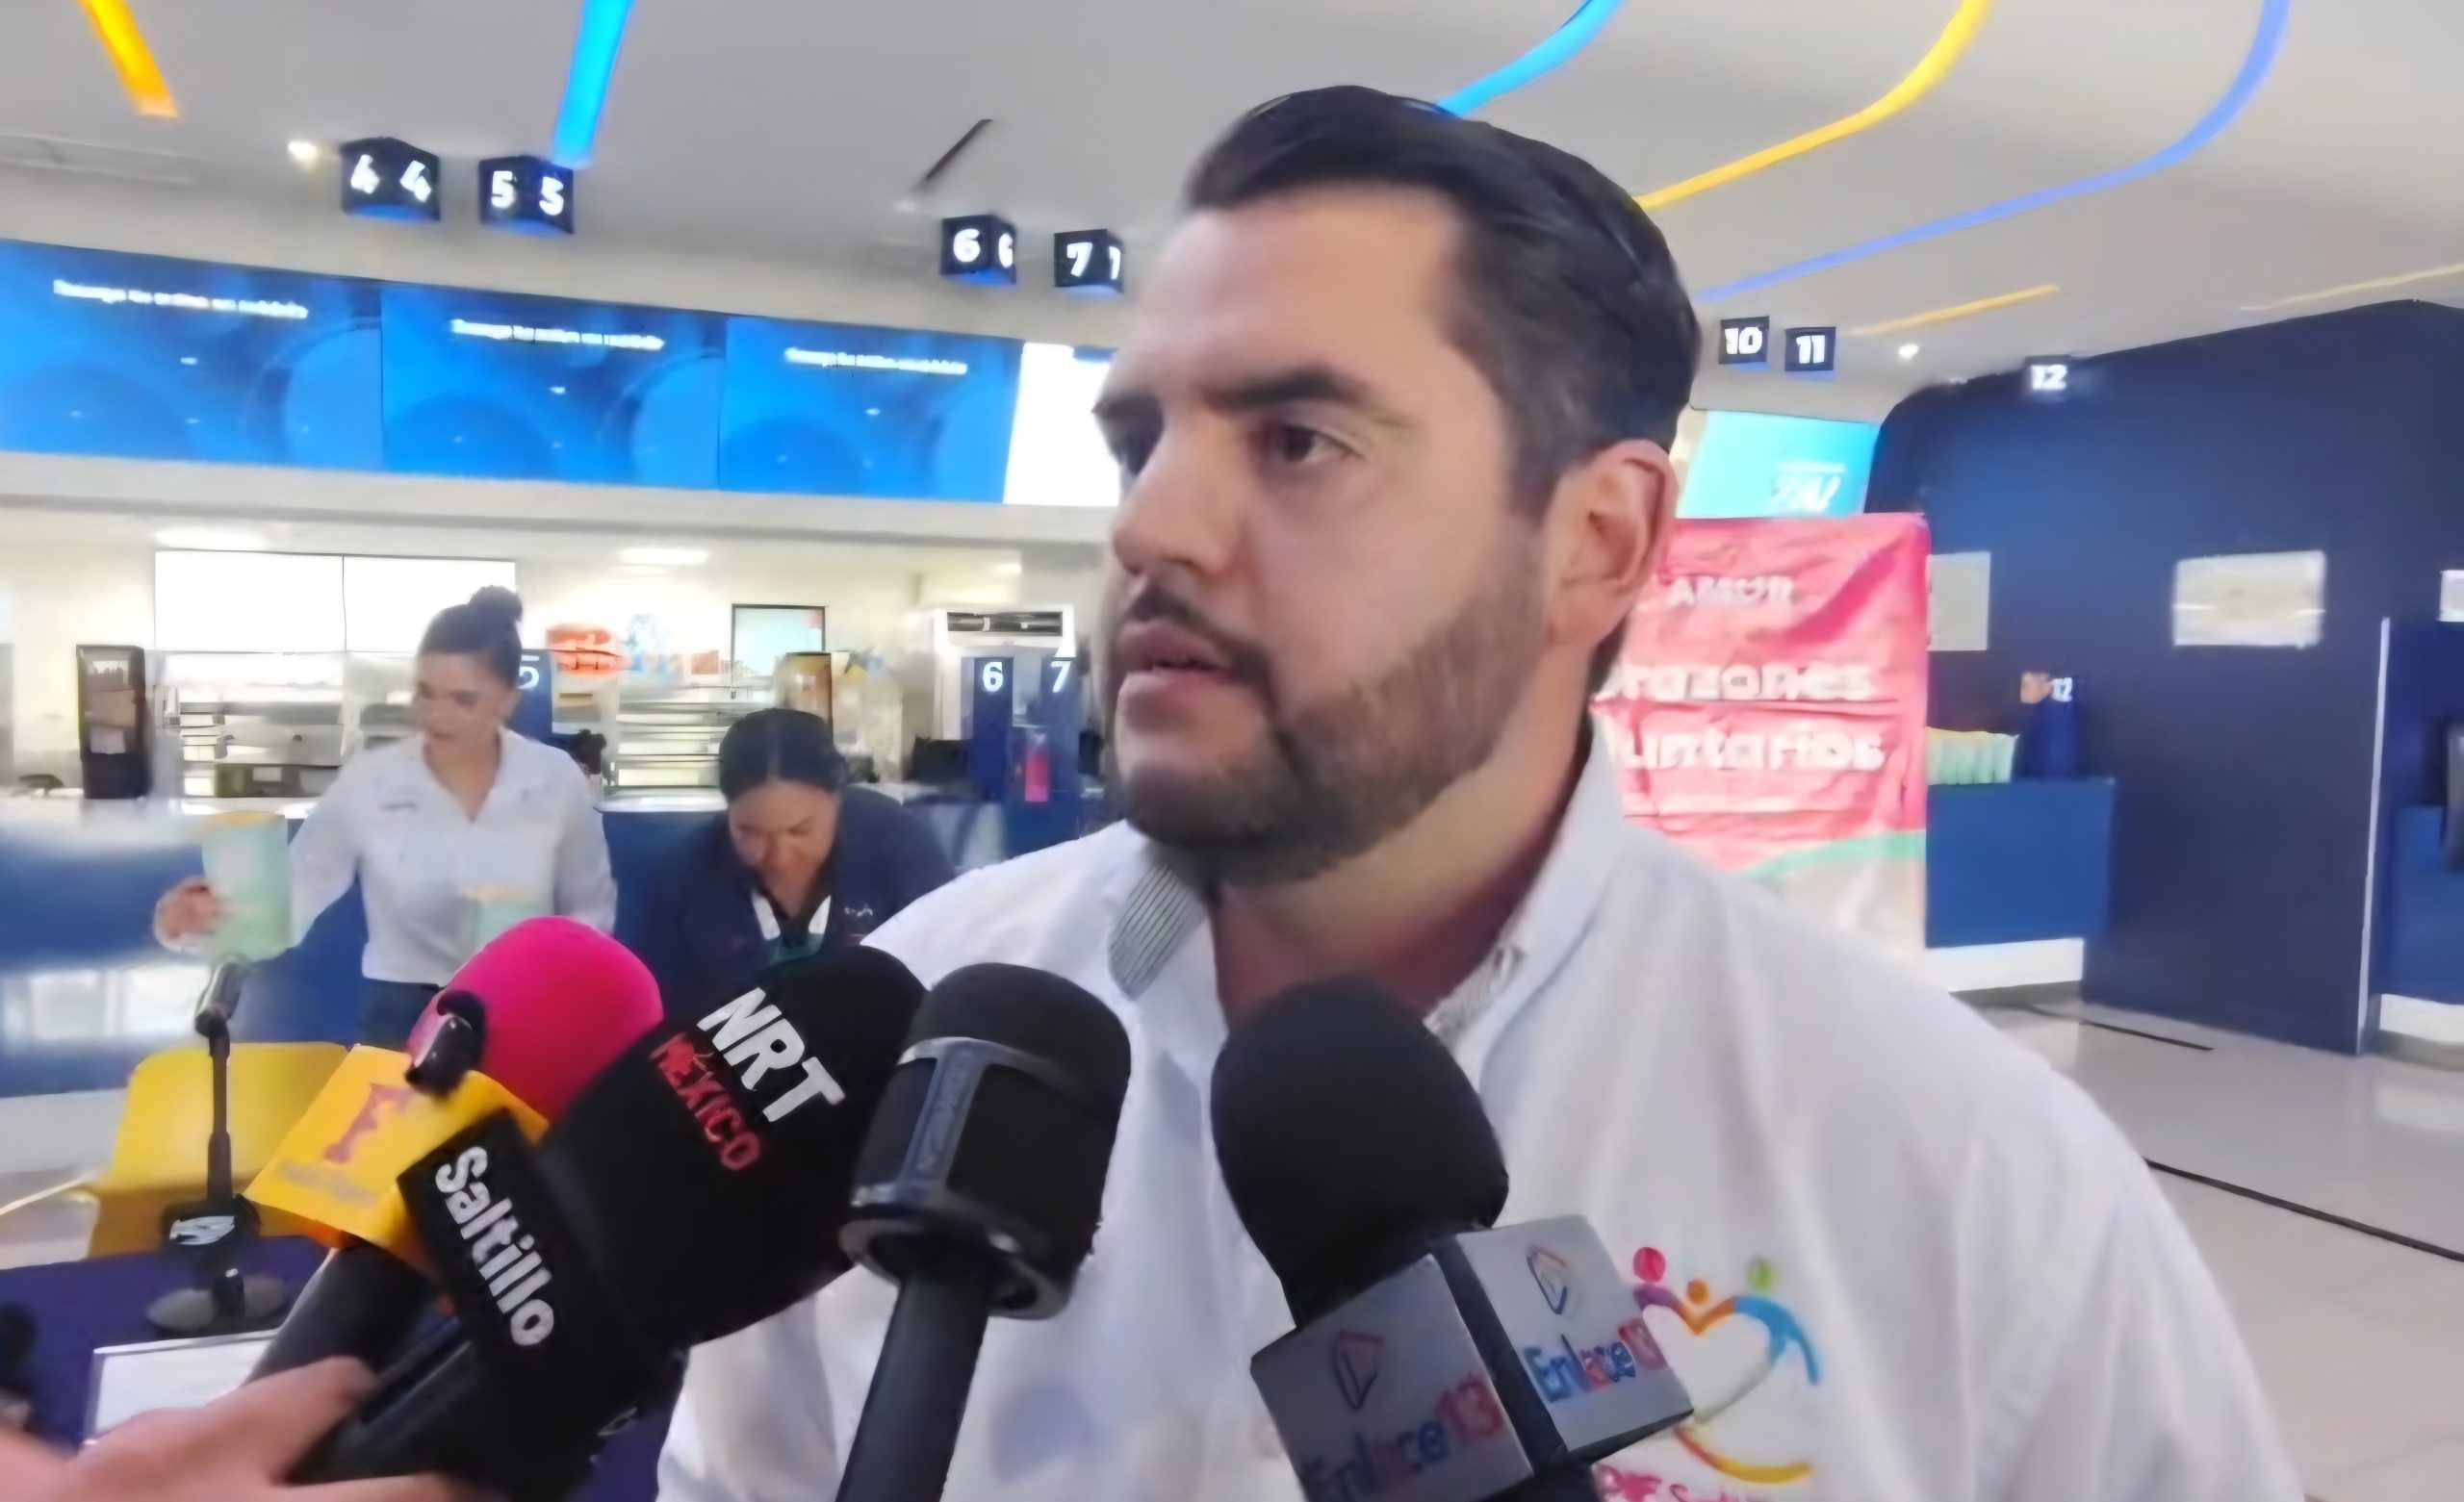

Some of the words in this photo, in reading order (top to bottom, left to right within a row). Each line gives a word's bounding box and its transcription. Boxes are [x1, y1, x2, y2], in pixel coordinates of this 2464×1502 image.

[350, 154, 380, 194] 4
[399, 160, 431, 202] 4
[491, 170, 517, 209] 5
[539, 176, 564, 216] 5
[953, 228, 981, 263] 6
[1066, 242, 1093, 277] 7
[1724, 326, 1763, 355] 10
[1796, 334, 1826, 364] 11
[2031, 365, 2068, 391] 12
[982, 661, 1004, 693] 6
[1050, 660, 1072, 694] 7
[696, 987, 846, 1123] NRT
[435, 1146, 555, 1346] Saltillo
